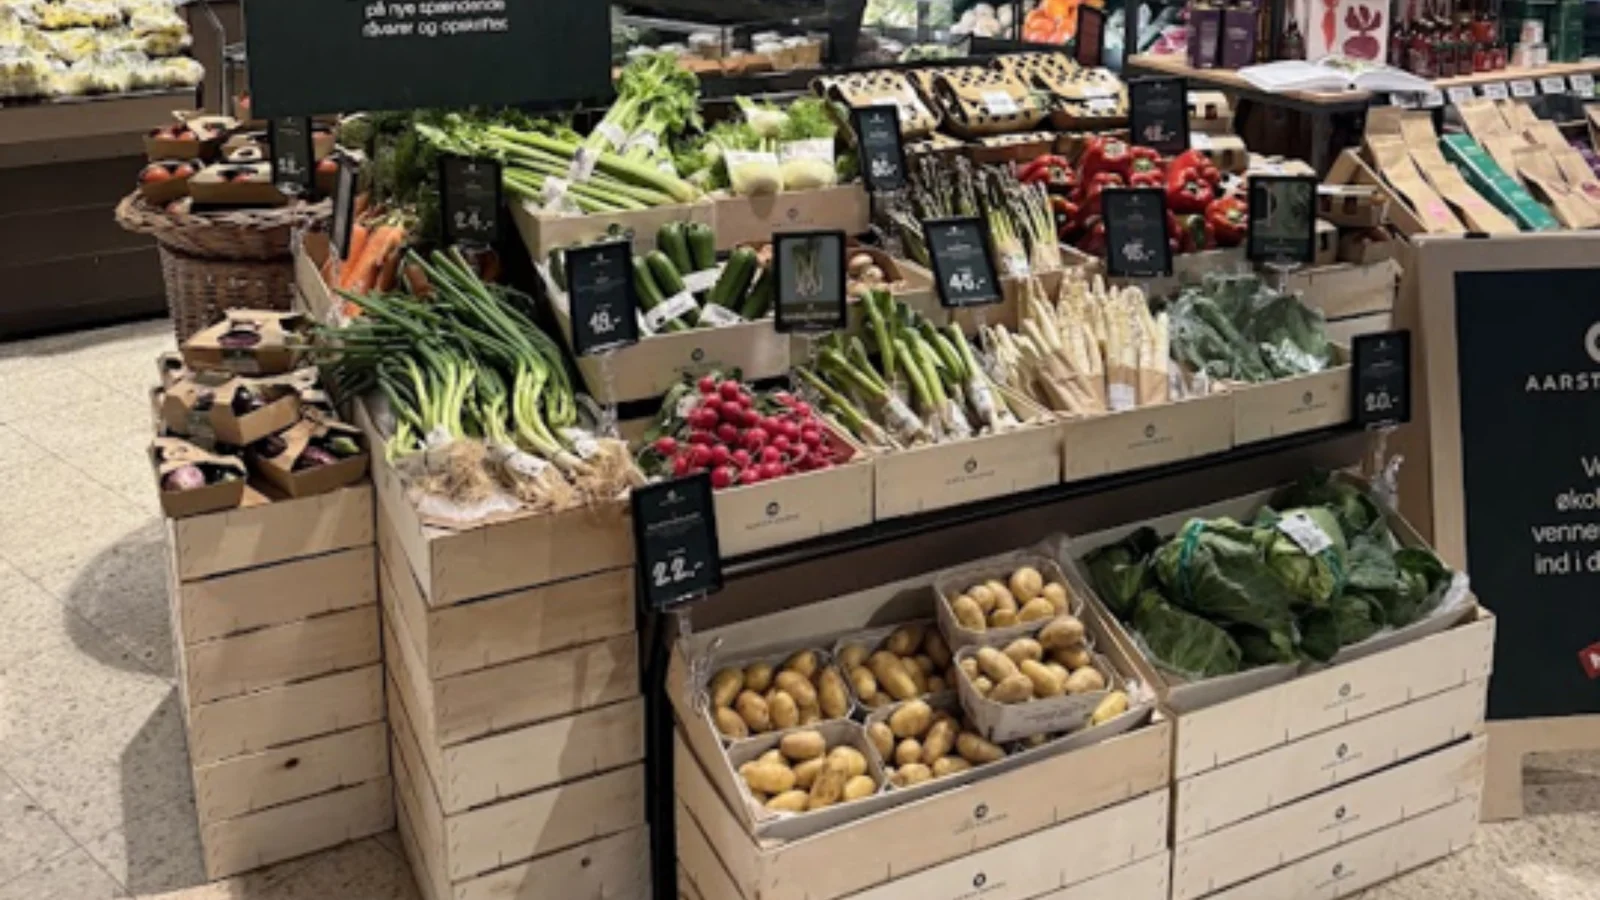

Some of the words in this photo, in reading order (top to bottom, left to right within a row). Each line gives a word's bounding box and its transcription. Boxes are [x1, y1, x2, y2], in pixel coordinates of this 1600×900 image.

[364, 2, 387, 18] på
[388, 3, 417, 18] nye
[361, 20, 413, 37] råvarer
[418, 21, 438, 37] og
[1524, 372, 1600, 393] AARST
[1534, 551, 1571, 575] ind
